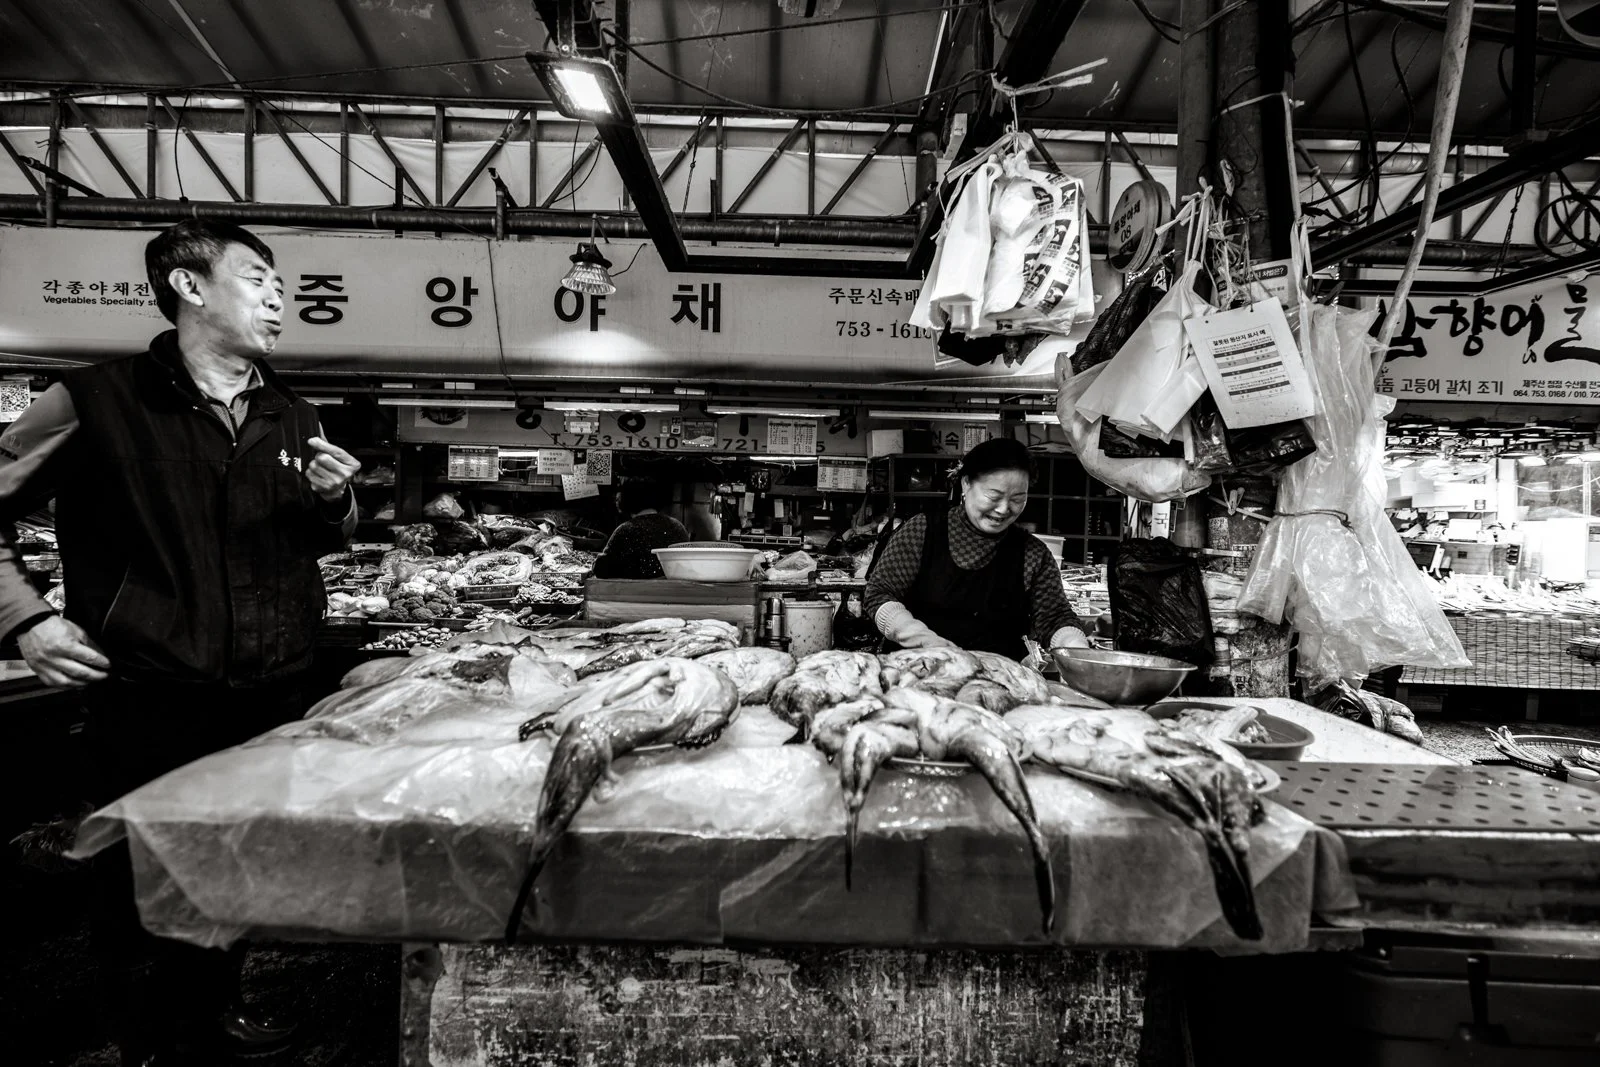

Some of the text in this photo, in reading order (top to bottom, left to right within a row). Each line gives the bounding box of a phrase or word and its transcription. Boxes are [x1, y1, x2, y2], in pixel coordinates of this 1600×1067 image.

[43, 296, 97, 305] Vegetables
[100, 297, 145, 307] Specialty
[1400, 378, 1440, 394] 고등어
[1445, 379, 1472, 395] 갈치
[1477, 380, 1504, 396] 조기
[1522, 379, 1546, 389] 제주산
[574, 434, 679, 450] 753-1610
